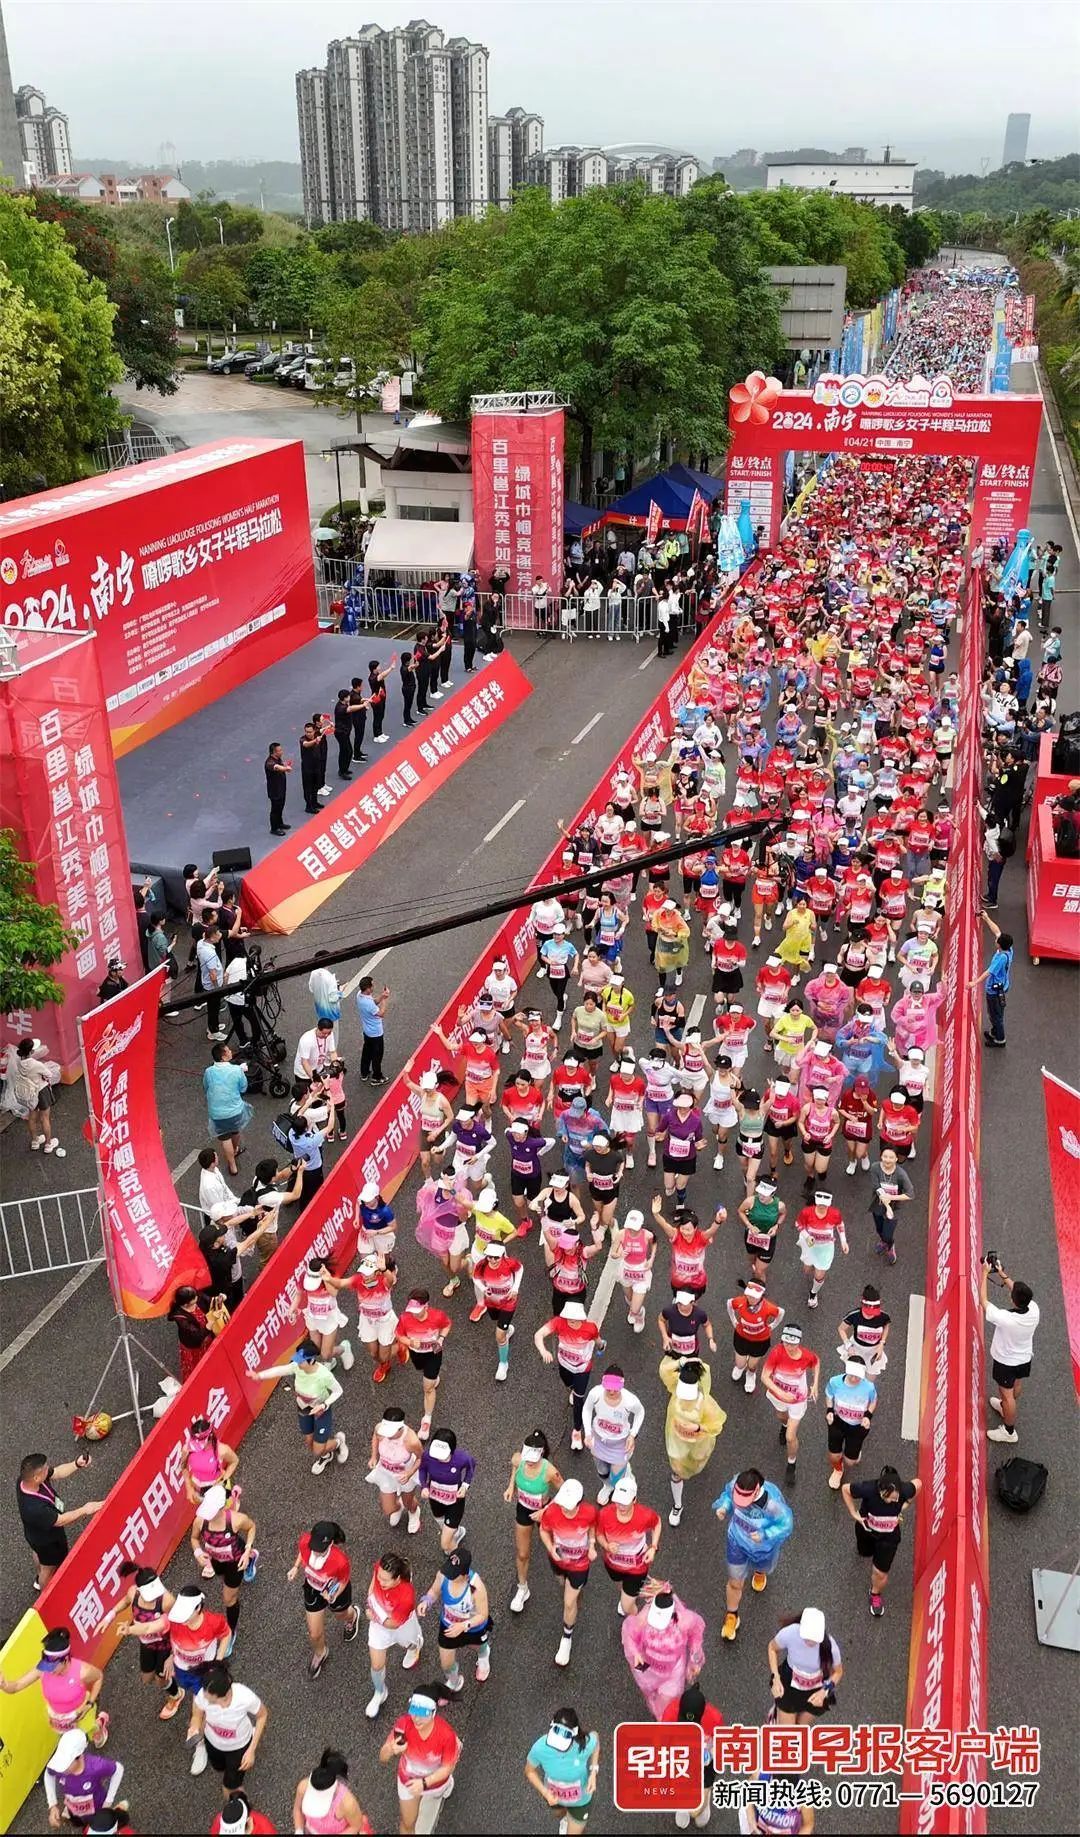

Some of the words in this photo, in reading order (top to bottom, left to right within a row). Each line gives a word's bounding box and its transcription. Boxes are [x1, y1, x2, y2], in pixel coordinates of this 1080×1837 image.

[297, 760, 420, 880] 百里邕江秀美如画
[418, 679, 505, 768] 绿城巾帼竞逐芳华
